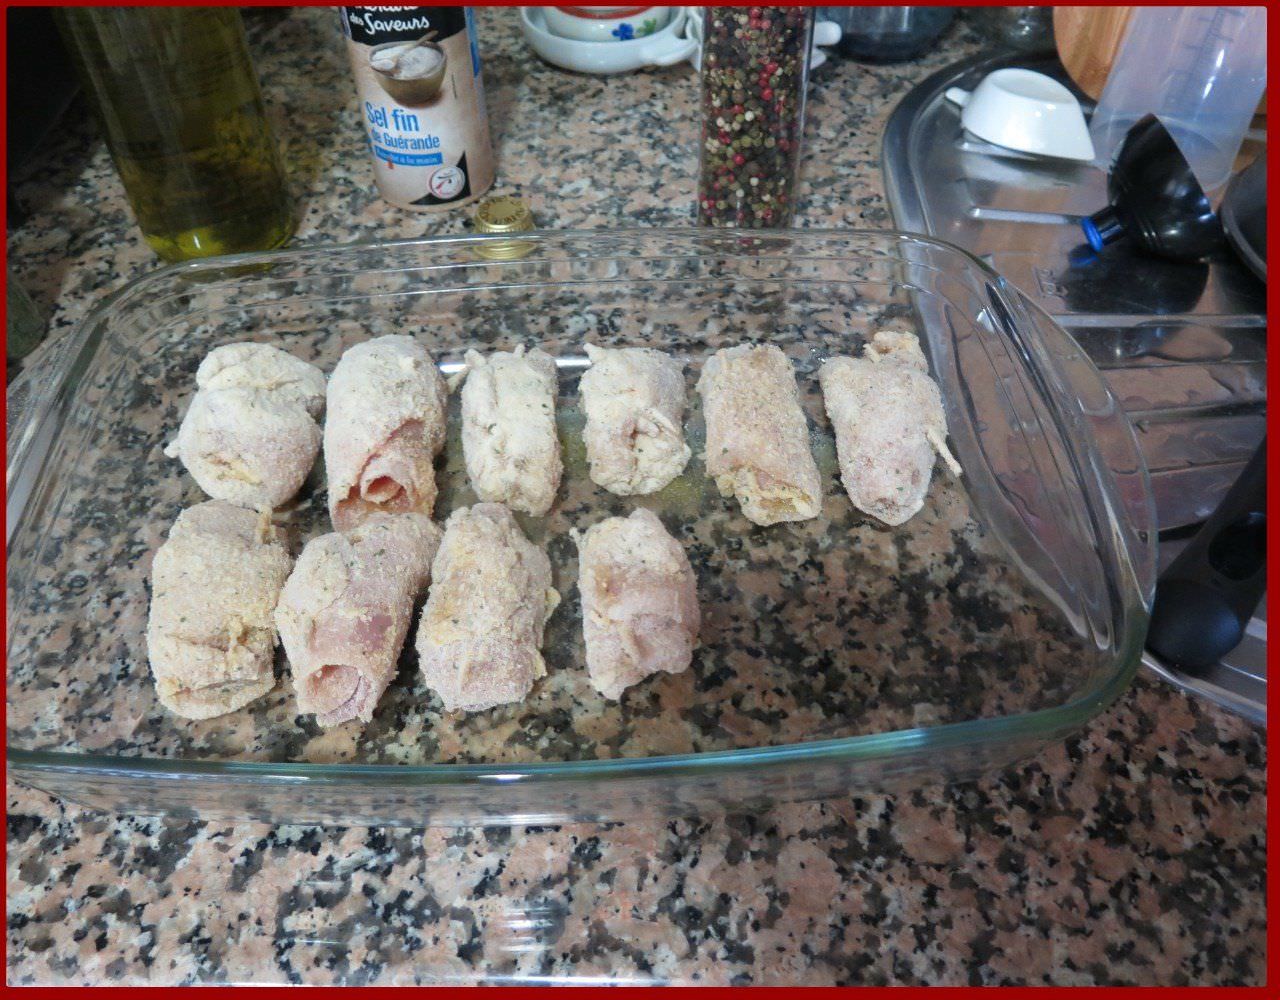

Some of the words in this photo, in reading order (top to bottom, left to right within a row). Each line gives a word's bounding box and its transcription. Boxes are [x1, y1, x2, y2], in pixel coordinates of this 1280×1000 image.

[363, 12, 431, 36] Saveurs
[365, 100, 388, 129] Sel
[391, 108, 419, 132] fin
[383, 131, 441, 151] Guérande
